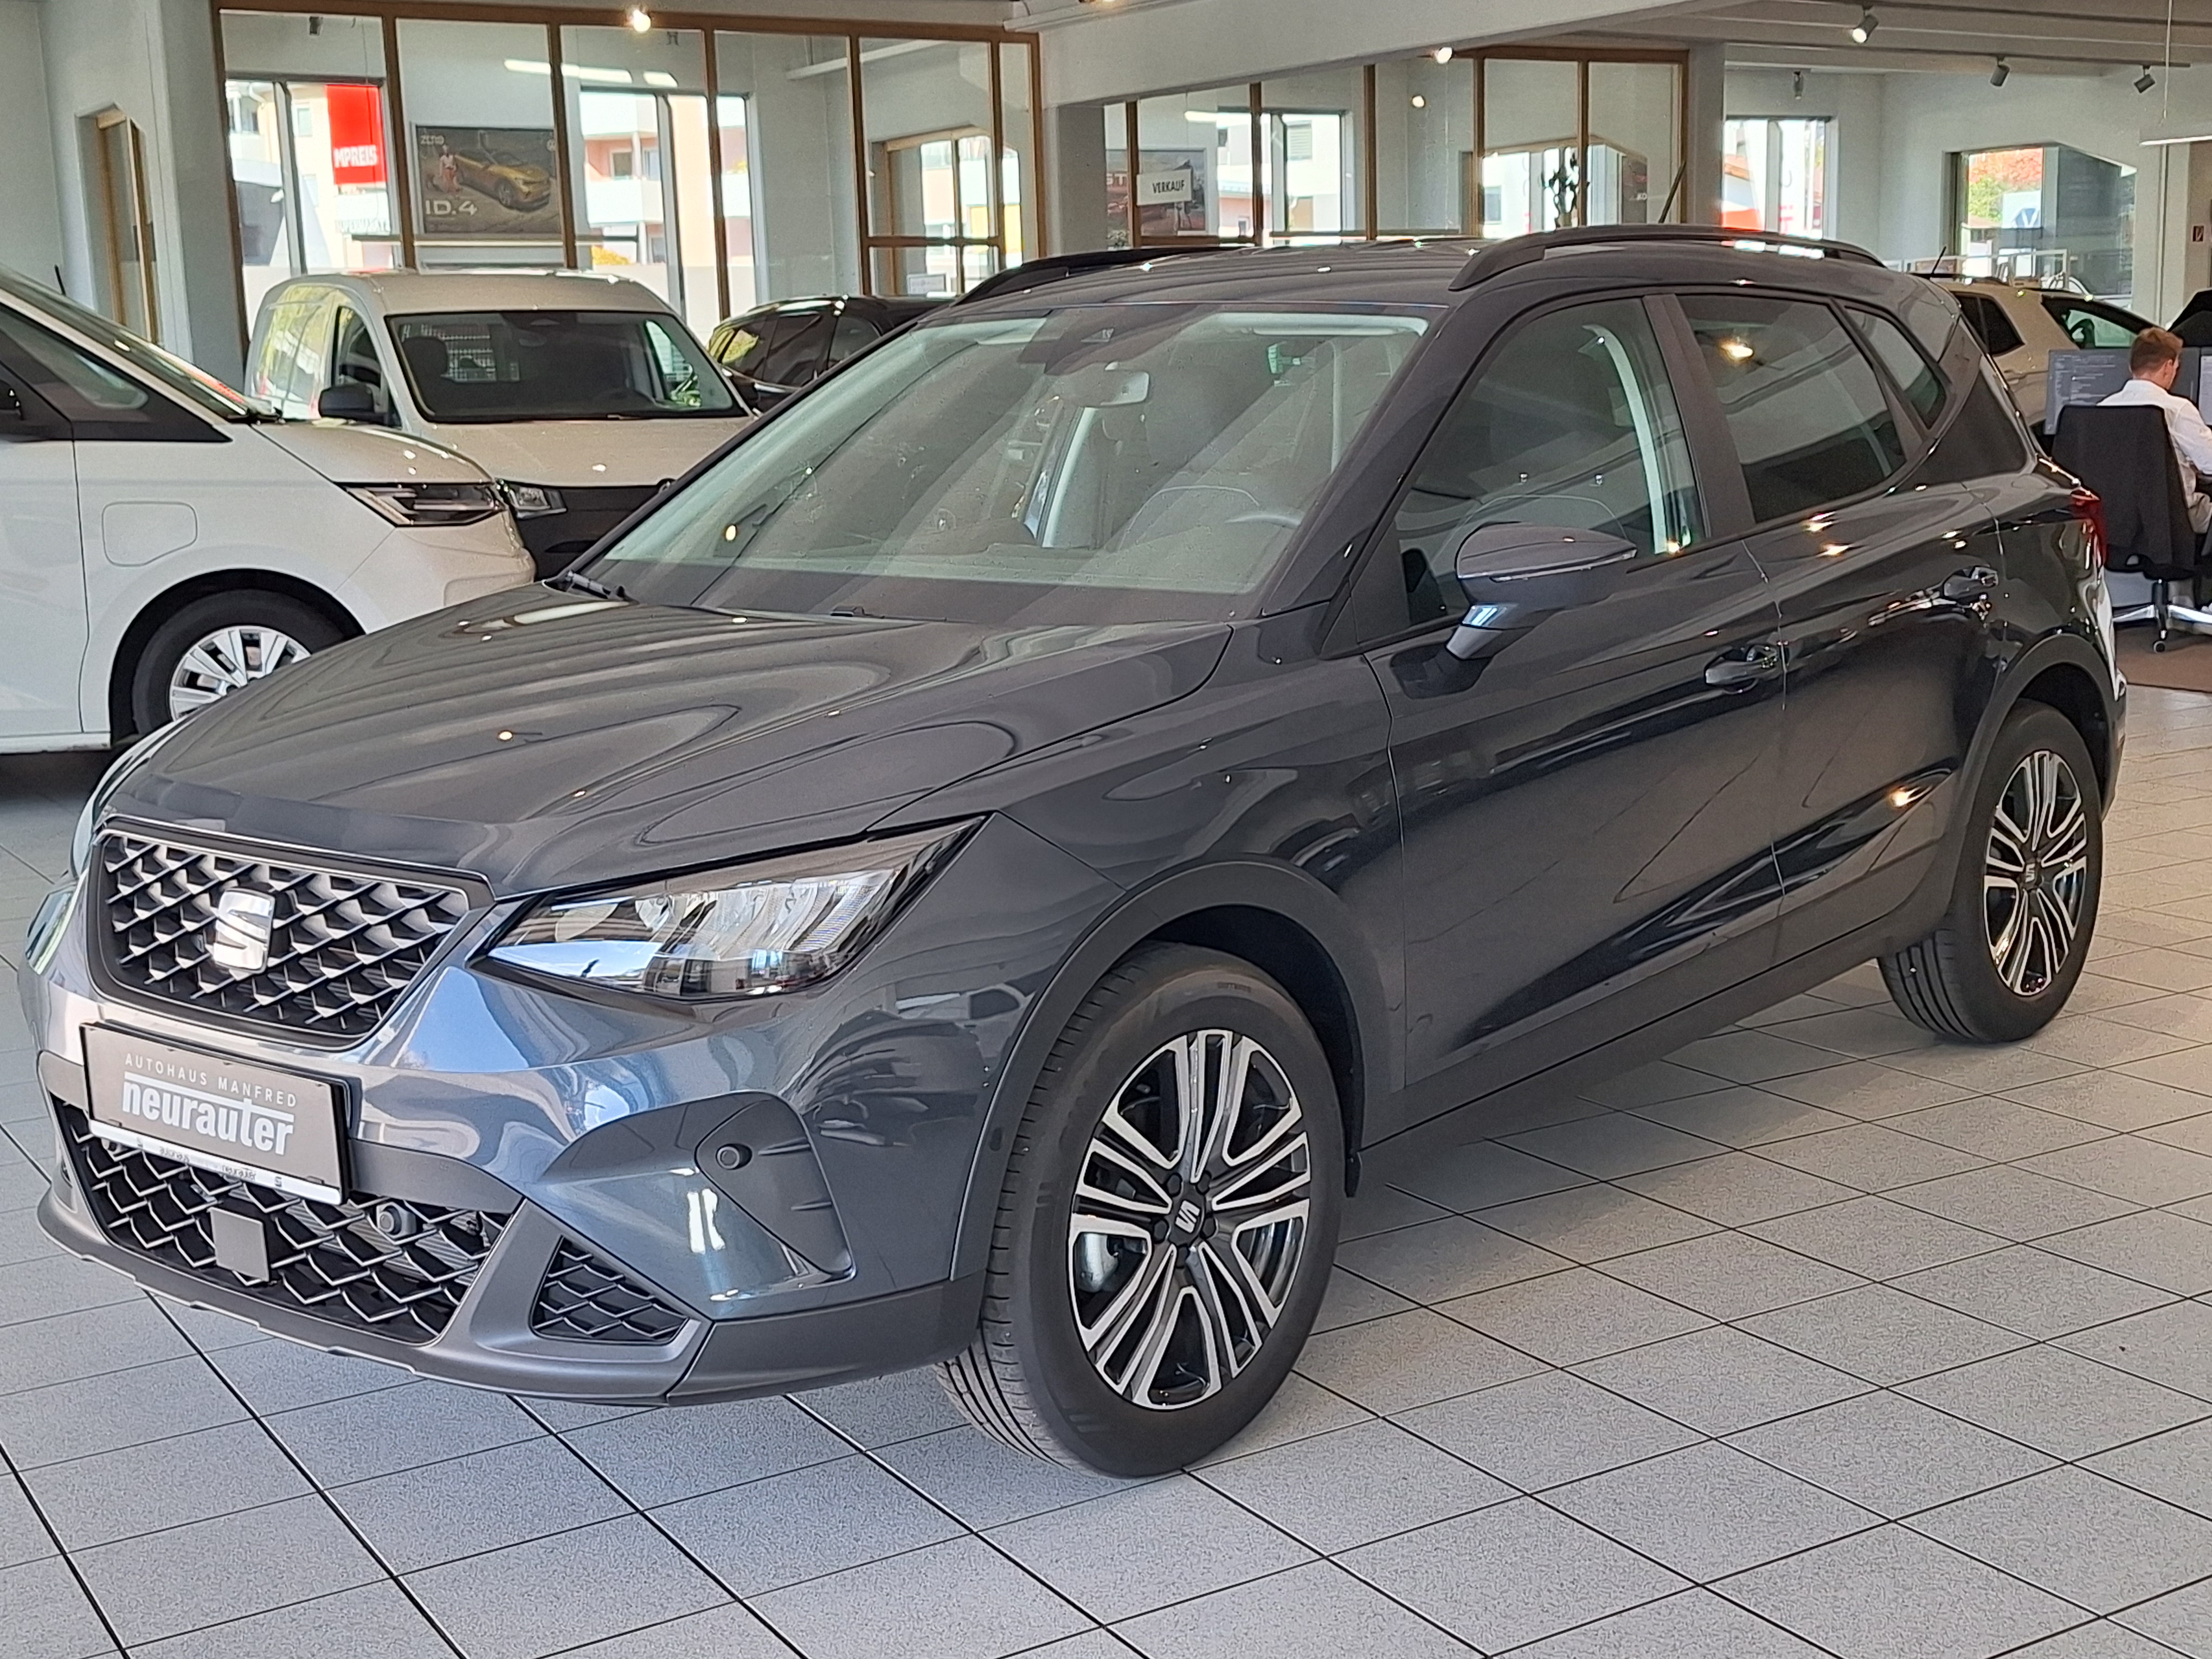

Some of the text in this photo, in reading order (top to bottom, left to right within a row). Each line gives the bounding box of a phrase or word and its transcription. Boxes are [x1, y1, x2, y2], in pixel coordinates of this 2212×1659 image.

[334, 145, 378, 168] MPREIS
[1152, 180, 1185, 194] VERKAUF
[426, 200, 478, 215] ID.4
[125, 1053, 297, 1108] AUTOHAUS MANFRED
[123, 1081, 294, 1155] neurauter
